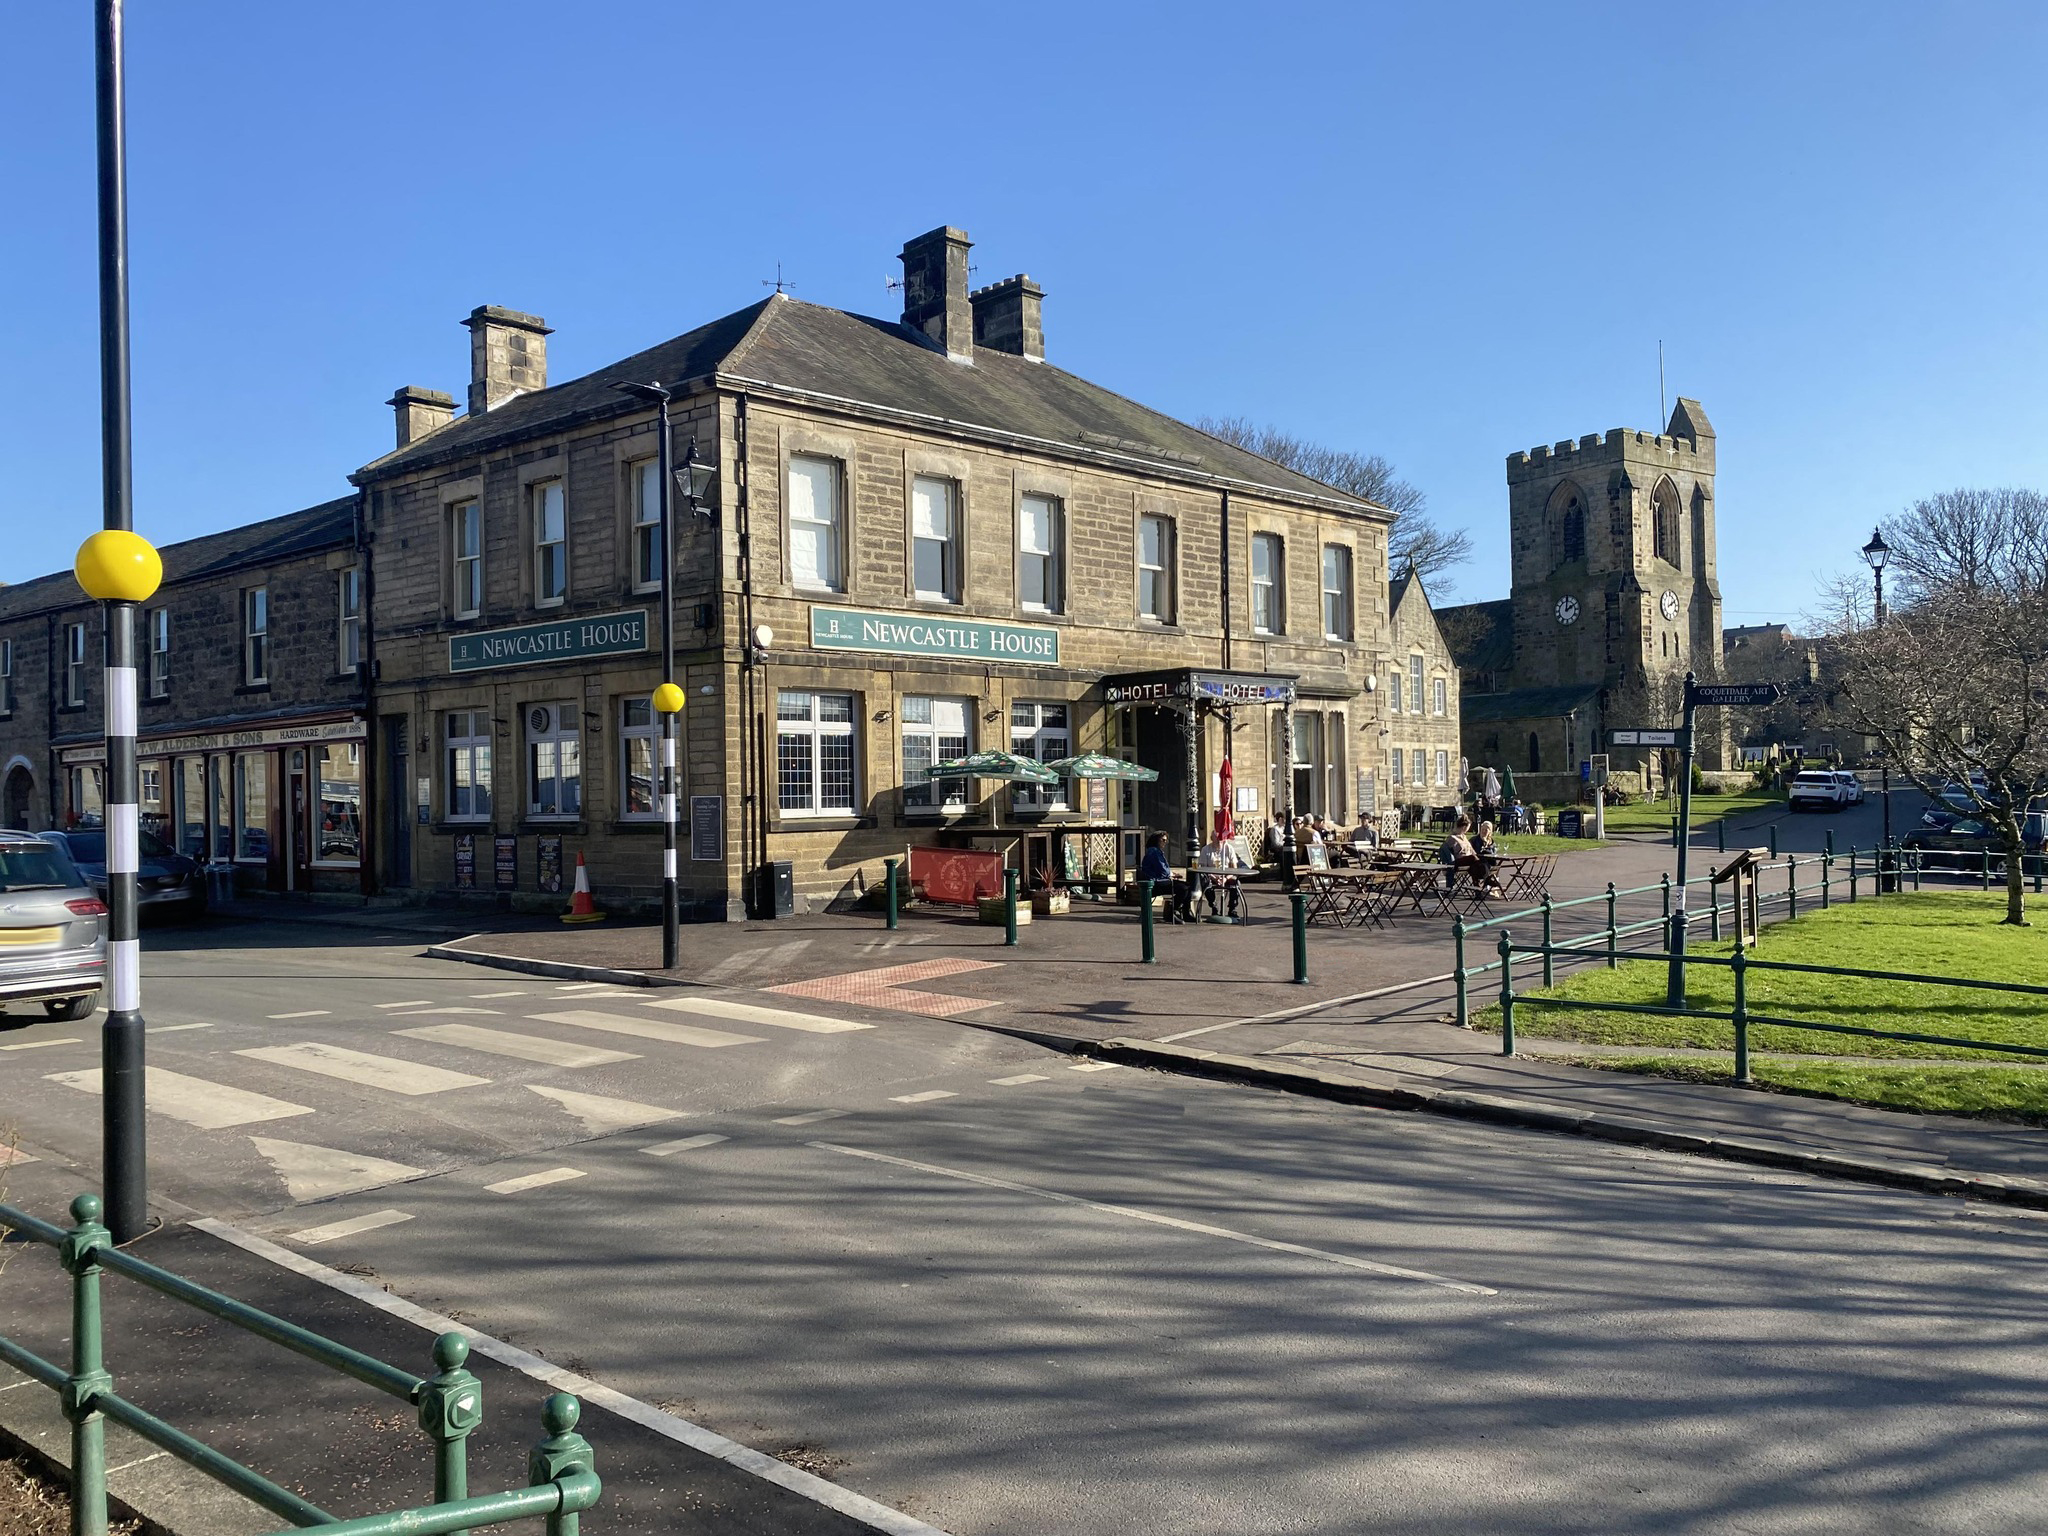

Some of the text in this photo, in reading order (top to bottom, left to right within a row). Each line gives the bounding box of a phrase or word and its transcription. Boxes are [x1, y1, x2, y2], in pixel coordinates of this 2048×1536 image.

[481, 621, 641, 660] NEWCASTLE HOUSE
[862, 619, 1053, 656] NEWCASTLE HOUSE
[1121, 683, 1175, 701] HOTEL
[1222, 683, 1266, 700] HOTEL
[1699, 687, 1770, 696] COQUETDALE ART
[1712, 695, 1753, 703] GALLERY
[233, 731, 264, 747] SONS
[280, 727, 320, 740] HARDWARE
